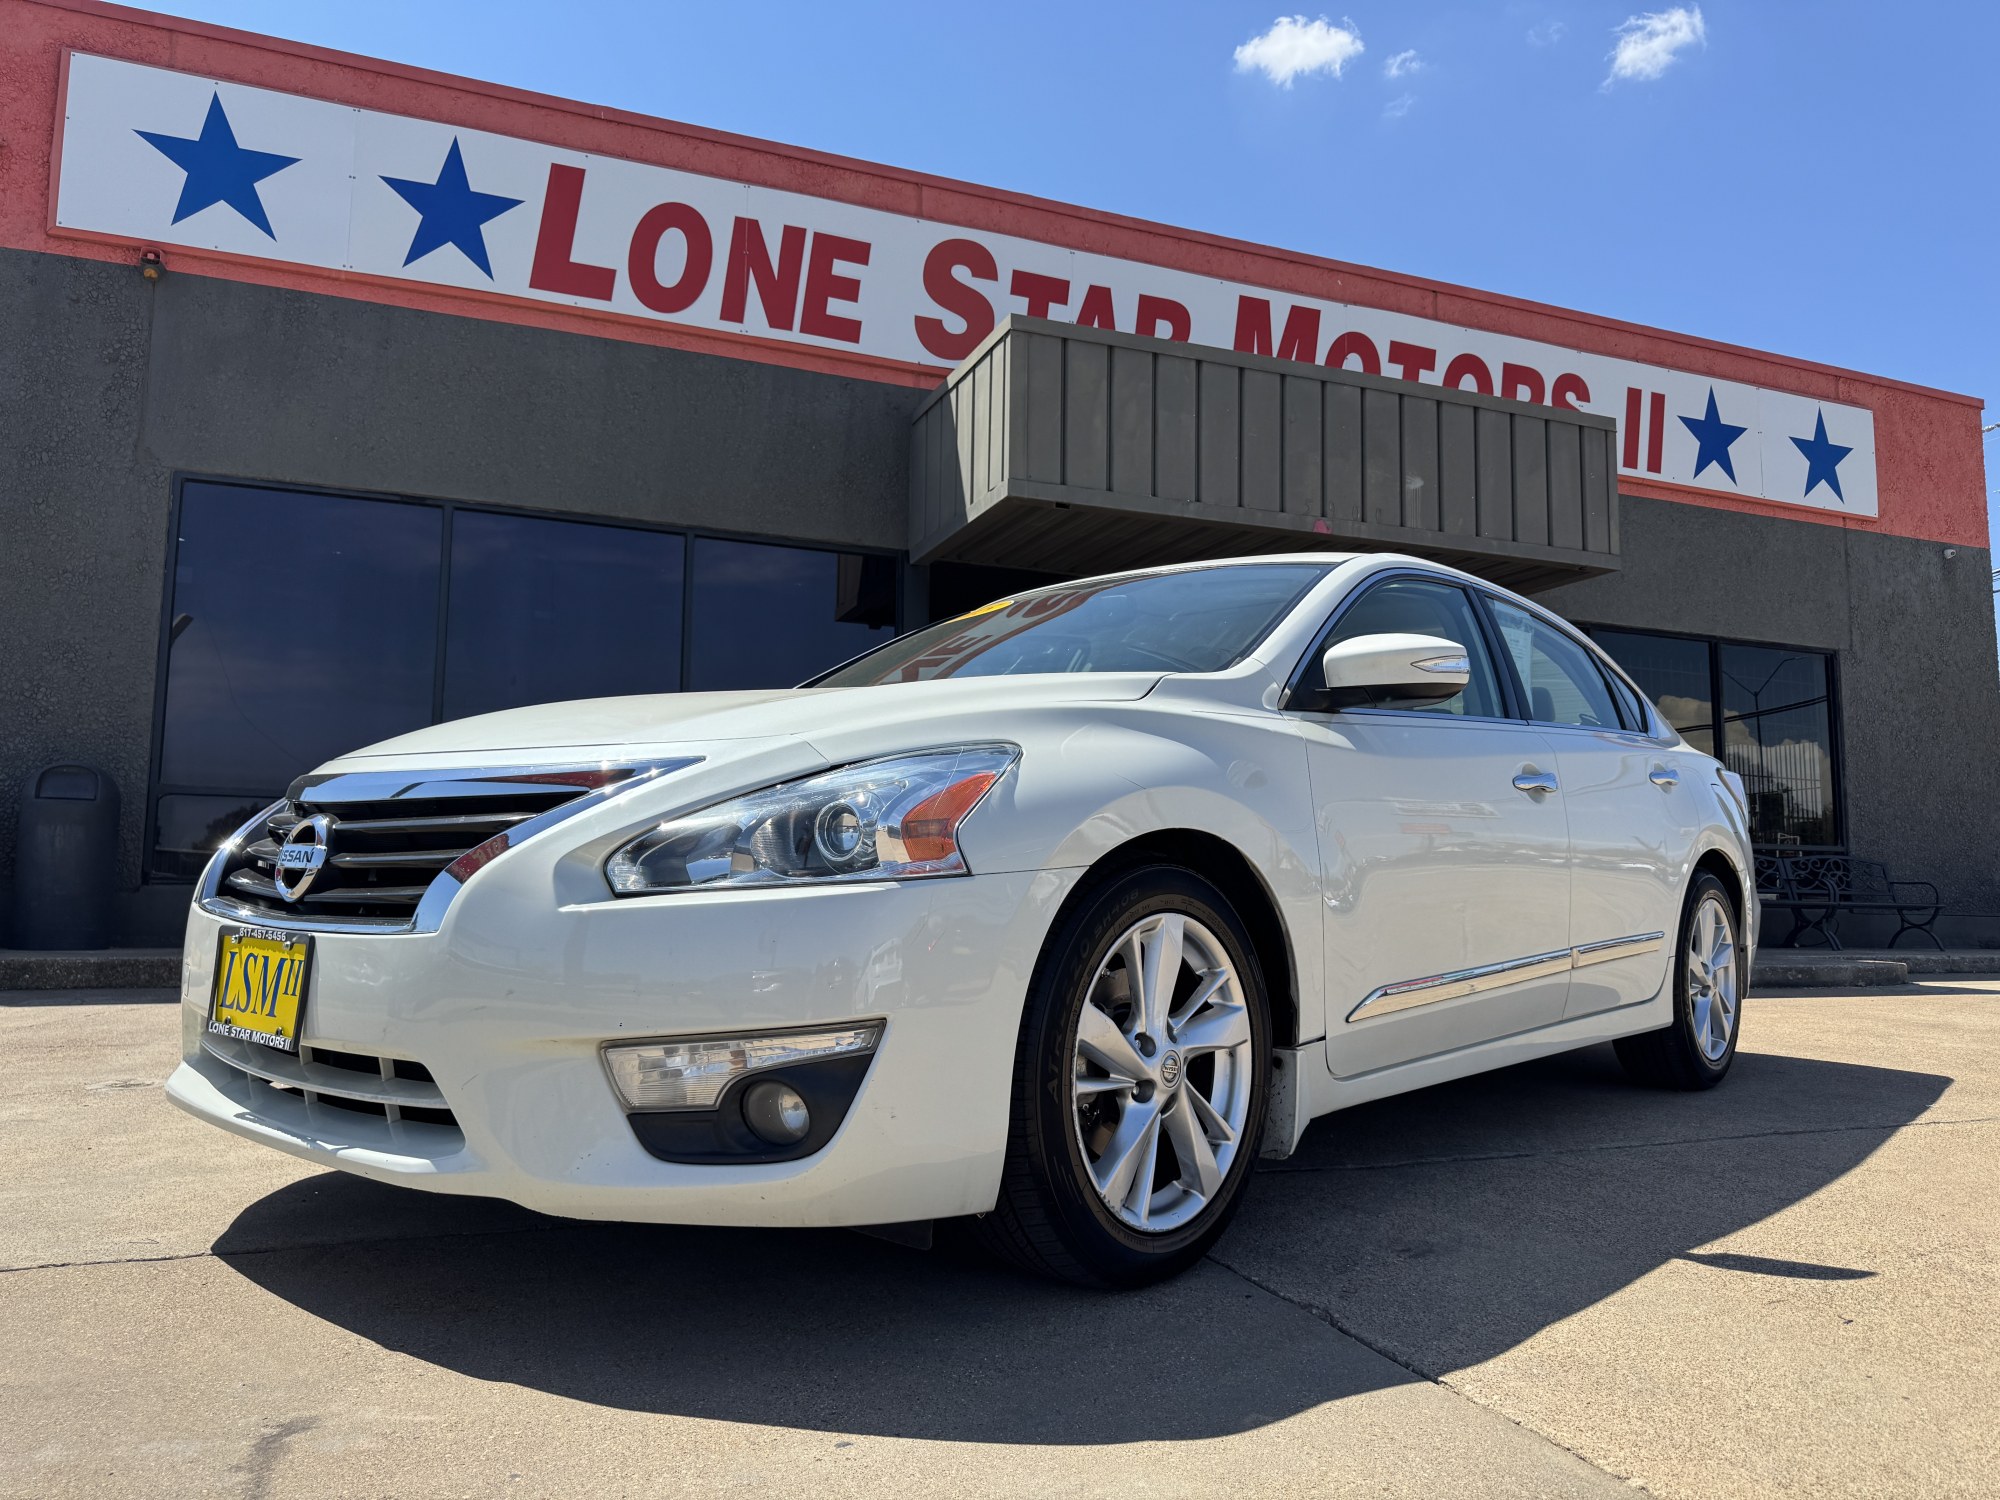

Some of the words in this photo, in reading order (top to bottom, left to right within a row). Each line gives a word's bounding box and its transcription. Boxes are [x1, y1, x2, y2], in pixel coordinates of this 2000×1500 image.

[529, 162, 871, 343] LONE
[1623, 387, 1665, 474] II
[278, 848, 316, 863] ISSAN
[240, 927, 287, 942] 817-457-5456
[208, 1020, 230, 1036] LONE
[230, 1026, 251, 1041] STAR
[251, 1031, 285, 1049] MOTORS
